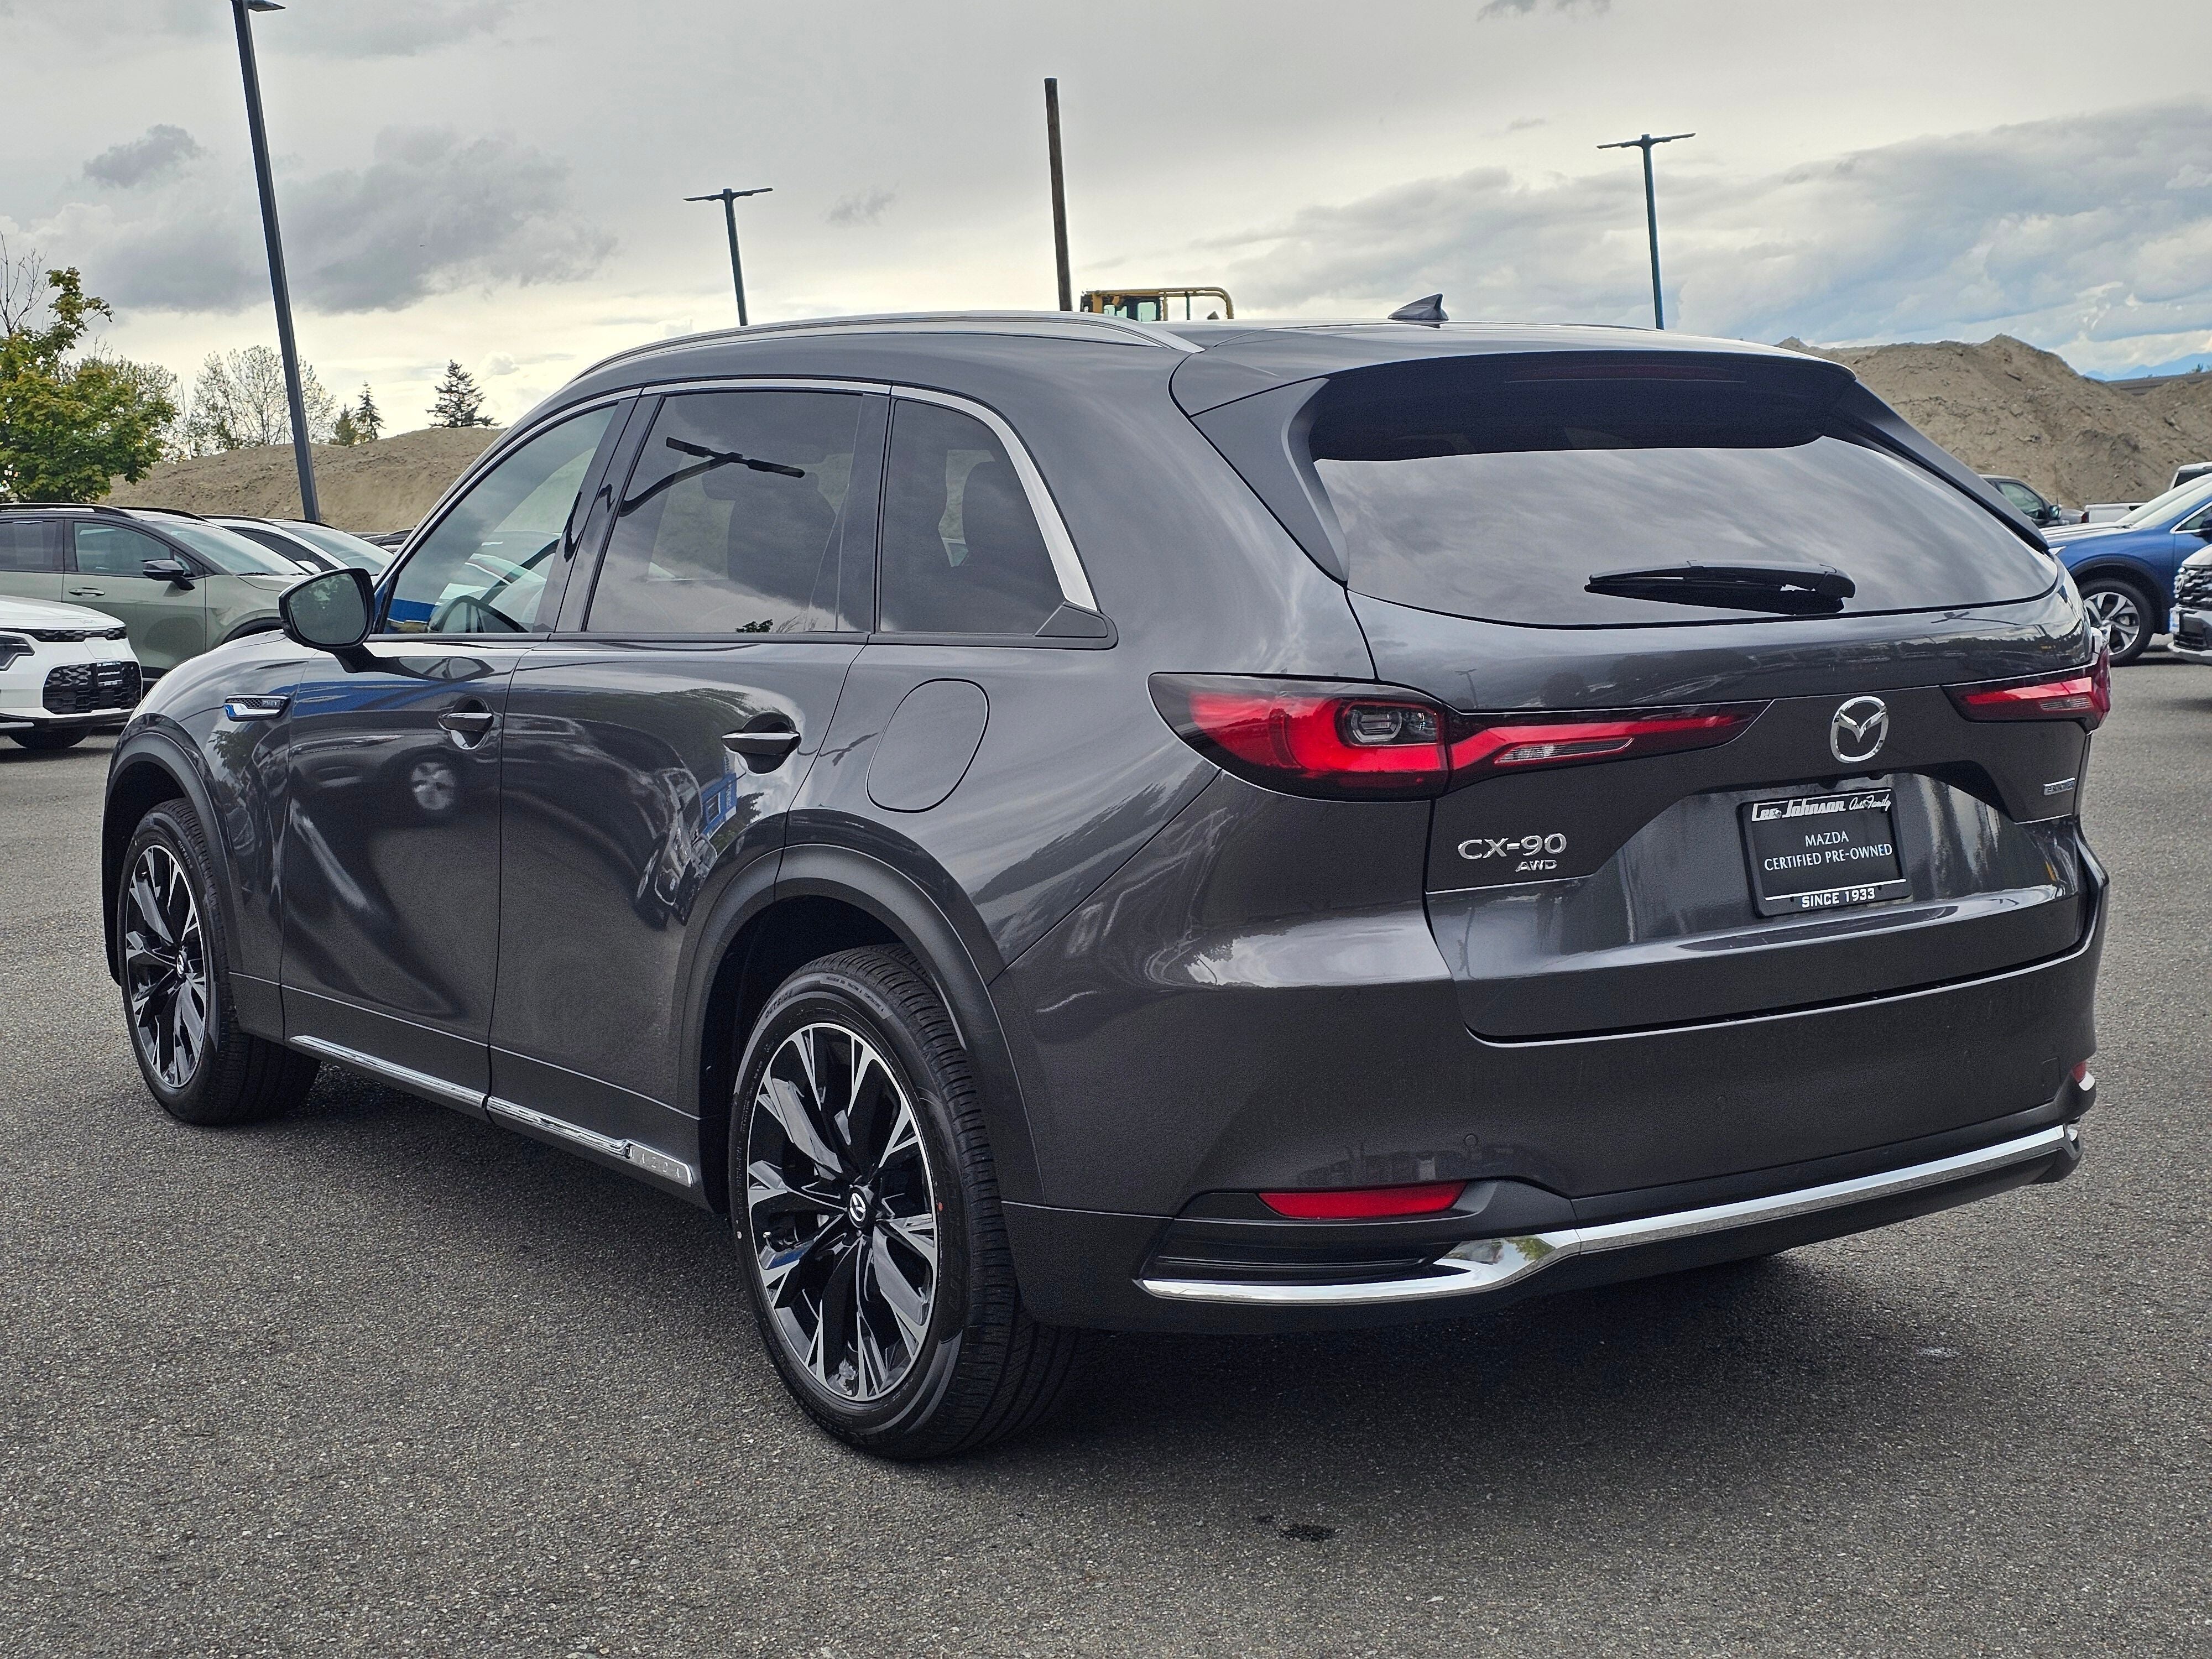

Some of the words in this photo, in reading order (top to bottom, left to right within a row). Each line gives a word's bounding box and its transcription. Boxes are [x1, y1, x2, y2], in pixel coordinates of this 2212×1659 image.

[1782, 798, 1846, 818] Johnson
[1849, 796, 1869, 811] Aut
[1458, 833, 1567, 859] CX-90
[1804, 830, 1849, 847] MAZDA
[1515, 859, 1557, 872] AWD
[1764, 852, 1822, 871] CERTIFIED
[1825, 843, 1892, 864] PRE-OWNED
[1802, 892, 1840, 908] SINCE
[1844, 888, 1875, 902] 1933
